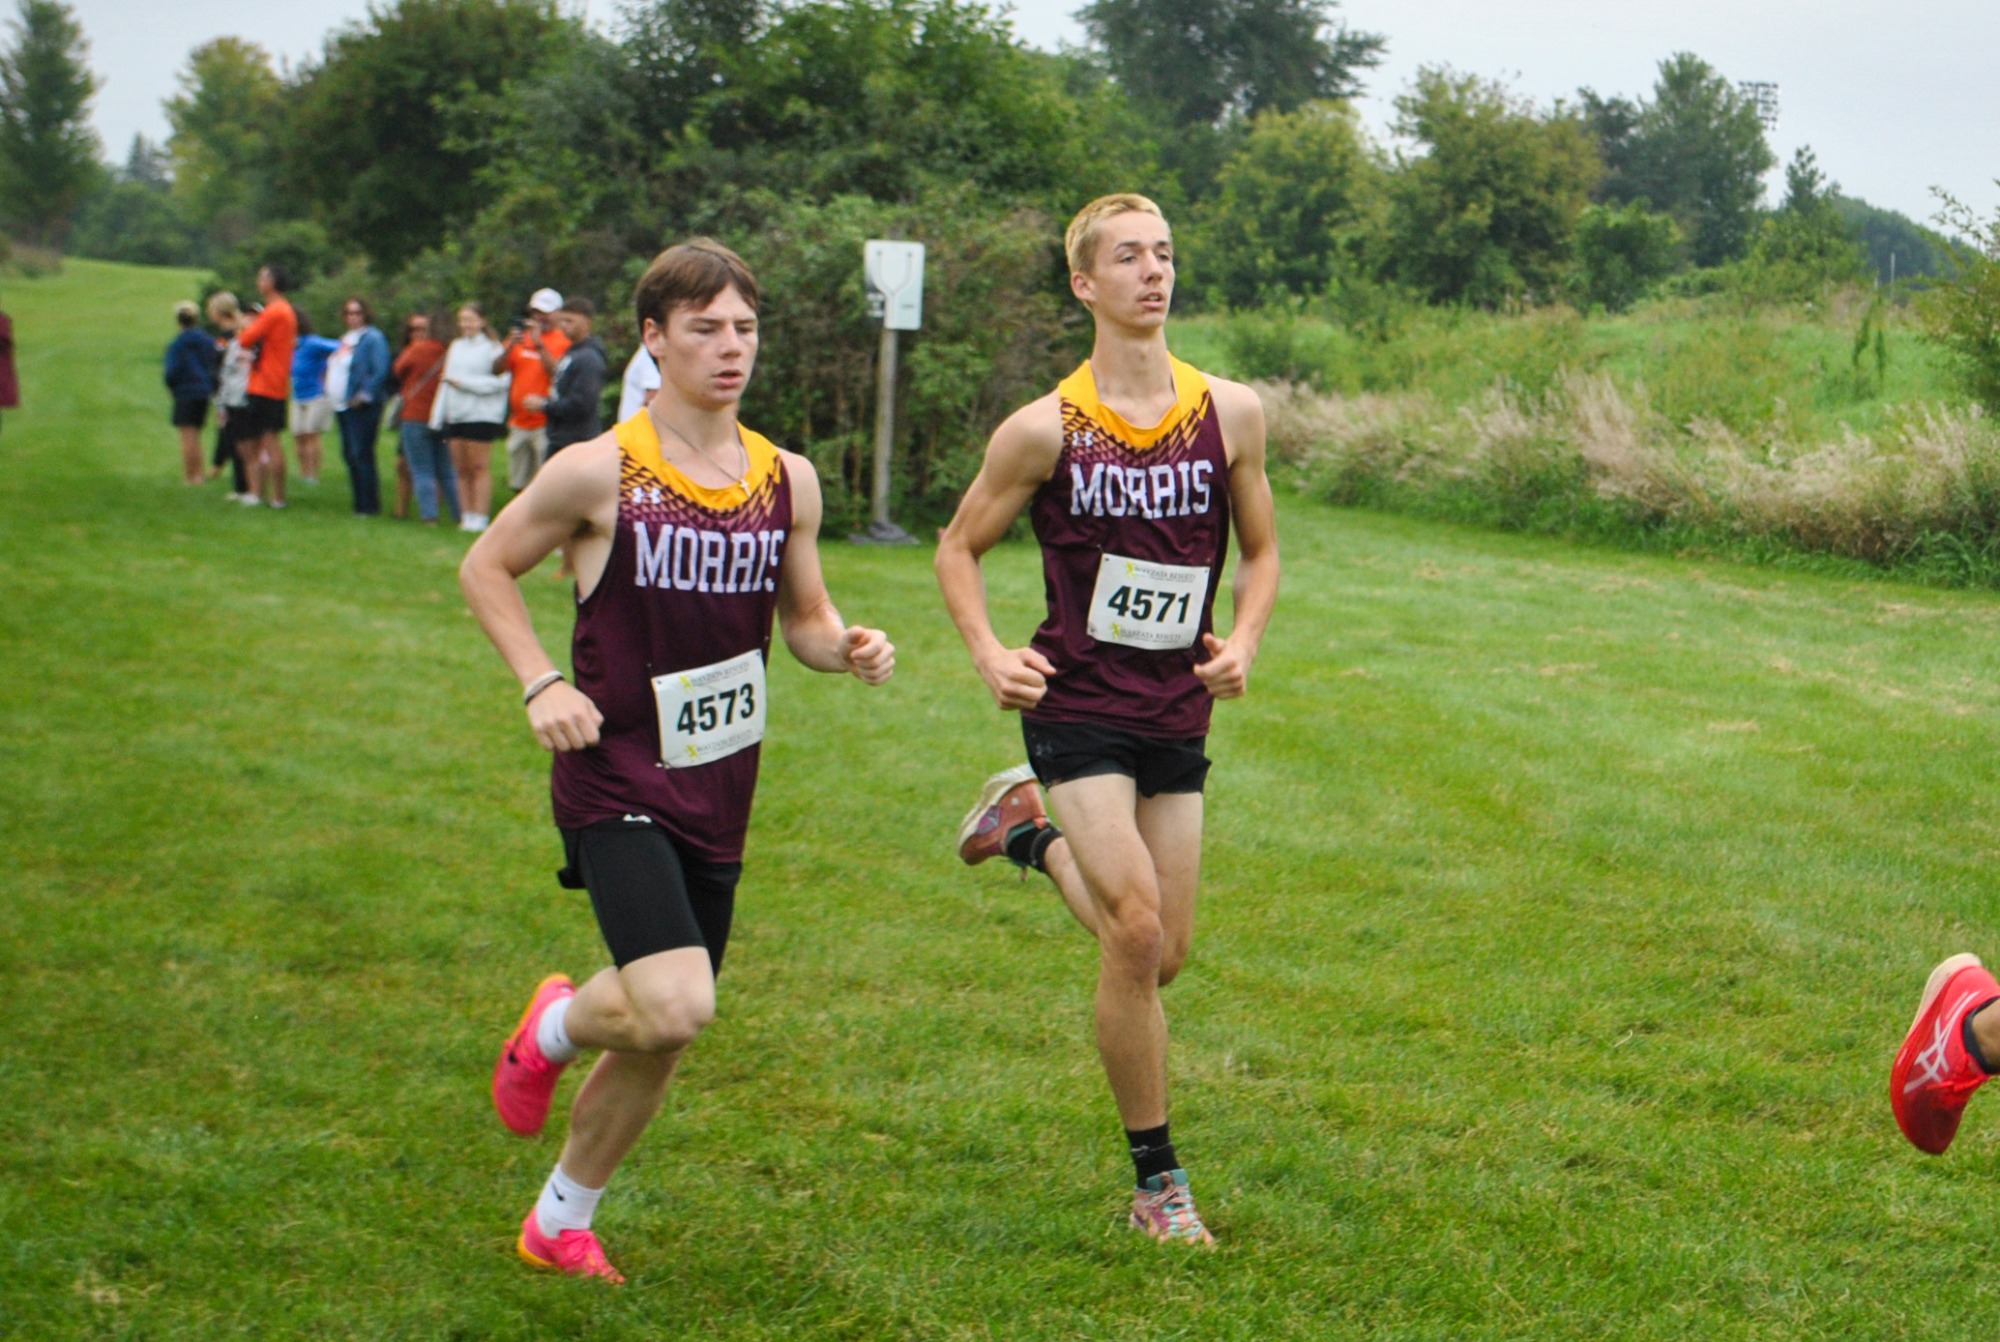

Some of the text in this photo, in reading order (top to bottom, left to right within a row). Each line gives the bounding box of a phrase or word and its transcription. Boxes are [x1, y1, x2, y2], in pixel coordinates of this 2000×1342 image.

[1070, 459, 1213, 519] MORRIS
[1107, 585, 1191, 624] 4571
[676, 682, 755, 736] 4573
